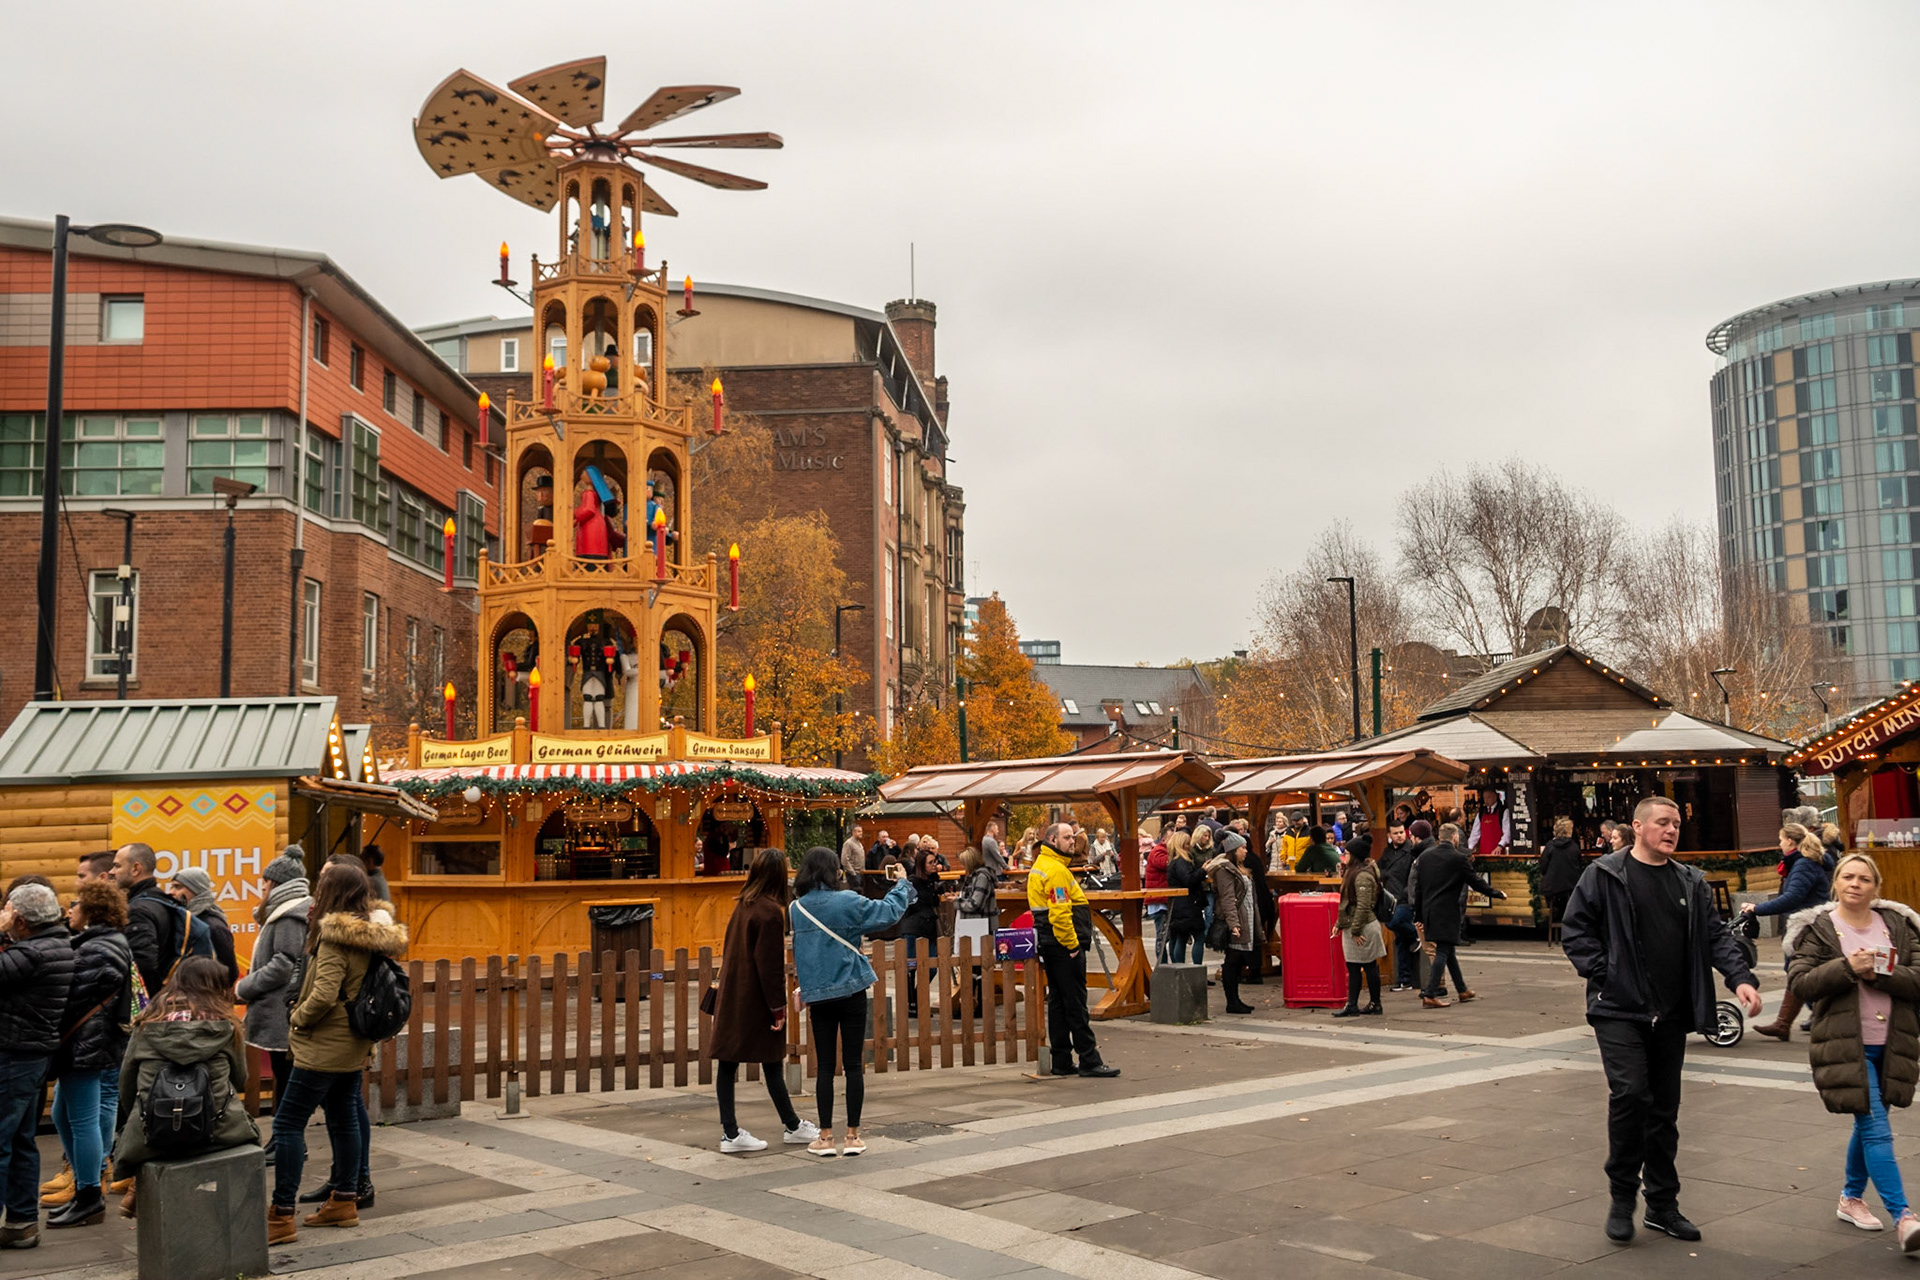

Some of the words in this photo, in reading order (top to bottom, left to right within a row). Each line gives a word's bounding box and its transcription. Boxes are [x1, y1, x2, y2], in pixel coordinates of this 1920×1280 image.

[778, 451, 845, 471] Music
[1817, 727, 1880, 770] DUTCH
[1882, 701, 1920, 736] MIN
[424, 750, 458, 763] German
[460, 748, 485, 761] Lager
[487, 746, 508, 759] Beer
[538, 745, 593, 759] German
[596, 744, 663, 758] Glühwein
[692, 742, 727, 756] German
[729, 744, 765, 758] Sausage
[153, 847, 261, 879] OUTH
